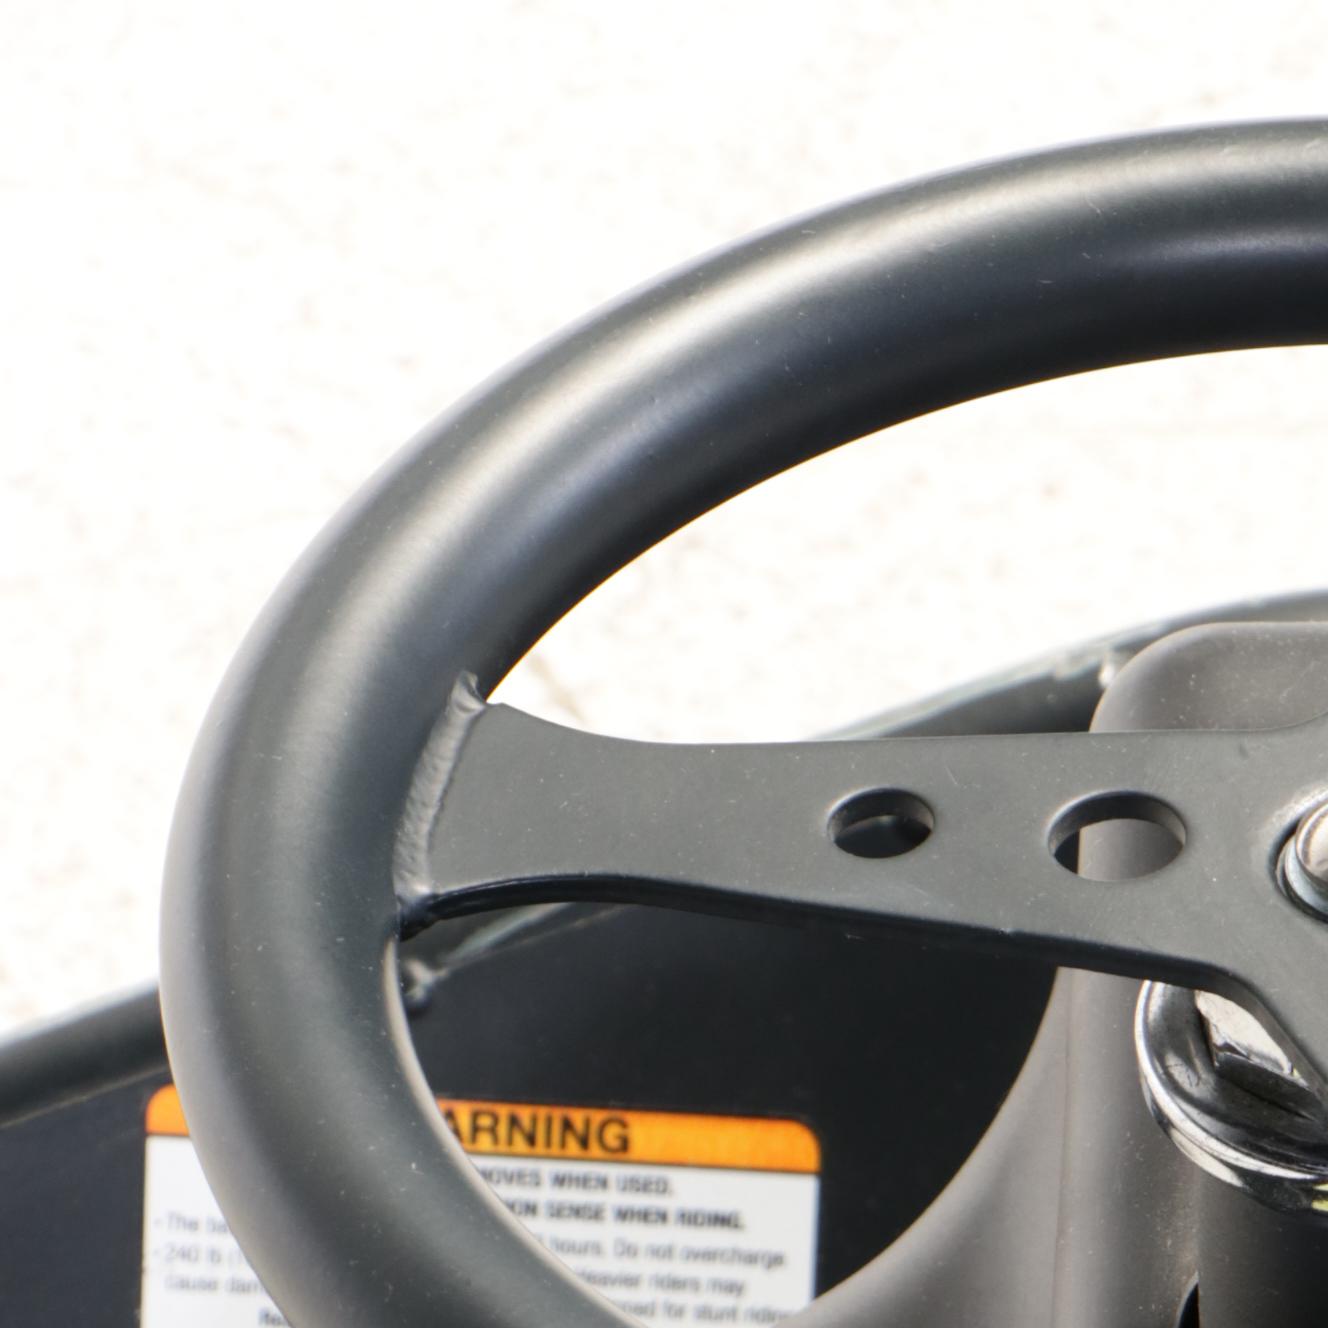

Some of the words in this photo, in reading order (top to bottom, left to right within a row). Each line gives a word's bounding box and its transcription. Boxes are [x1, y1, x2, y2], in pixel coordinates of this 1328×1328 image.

[442, 1108, 630, 1153] ARNING
[552, 1171, 609, 1191] WHEN
[545, 1199, 606, 1221] SENSE
[612, 1204, 668, 1225] WHEN
[612, 1236, 637, 1258] Do
[645, 1239, 675, 1260] not
[706, 1277, 746, 1298] may
